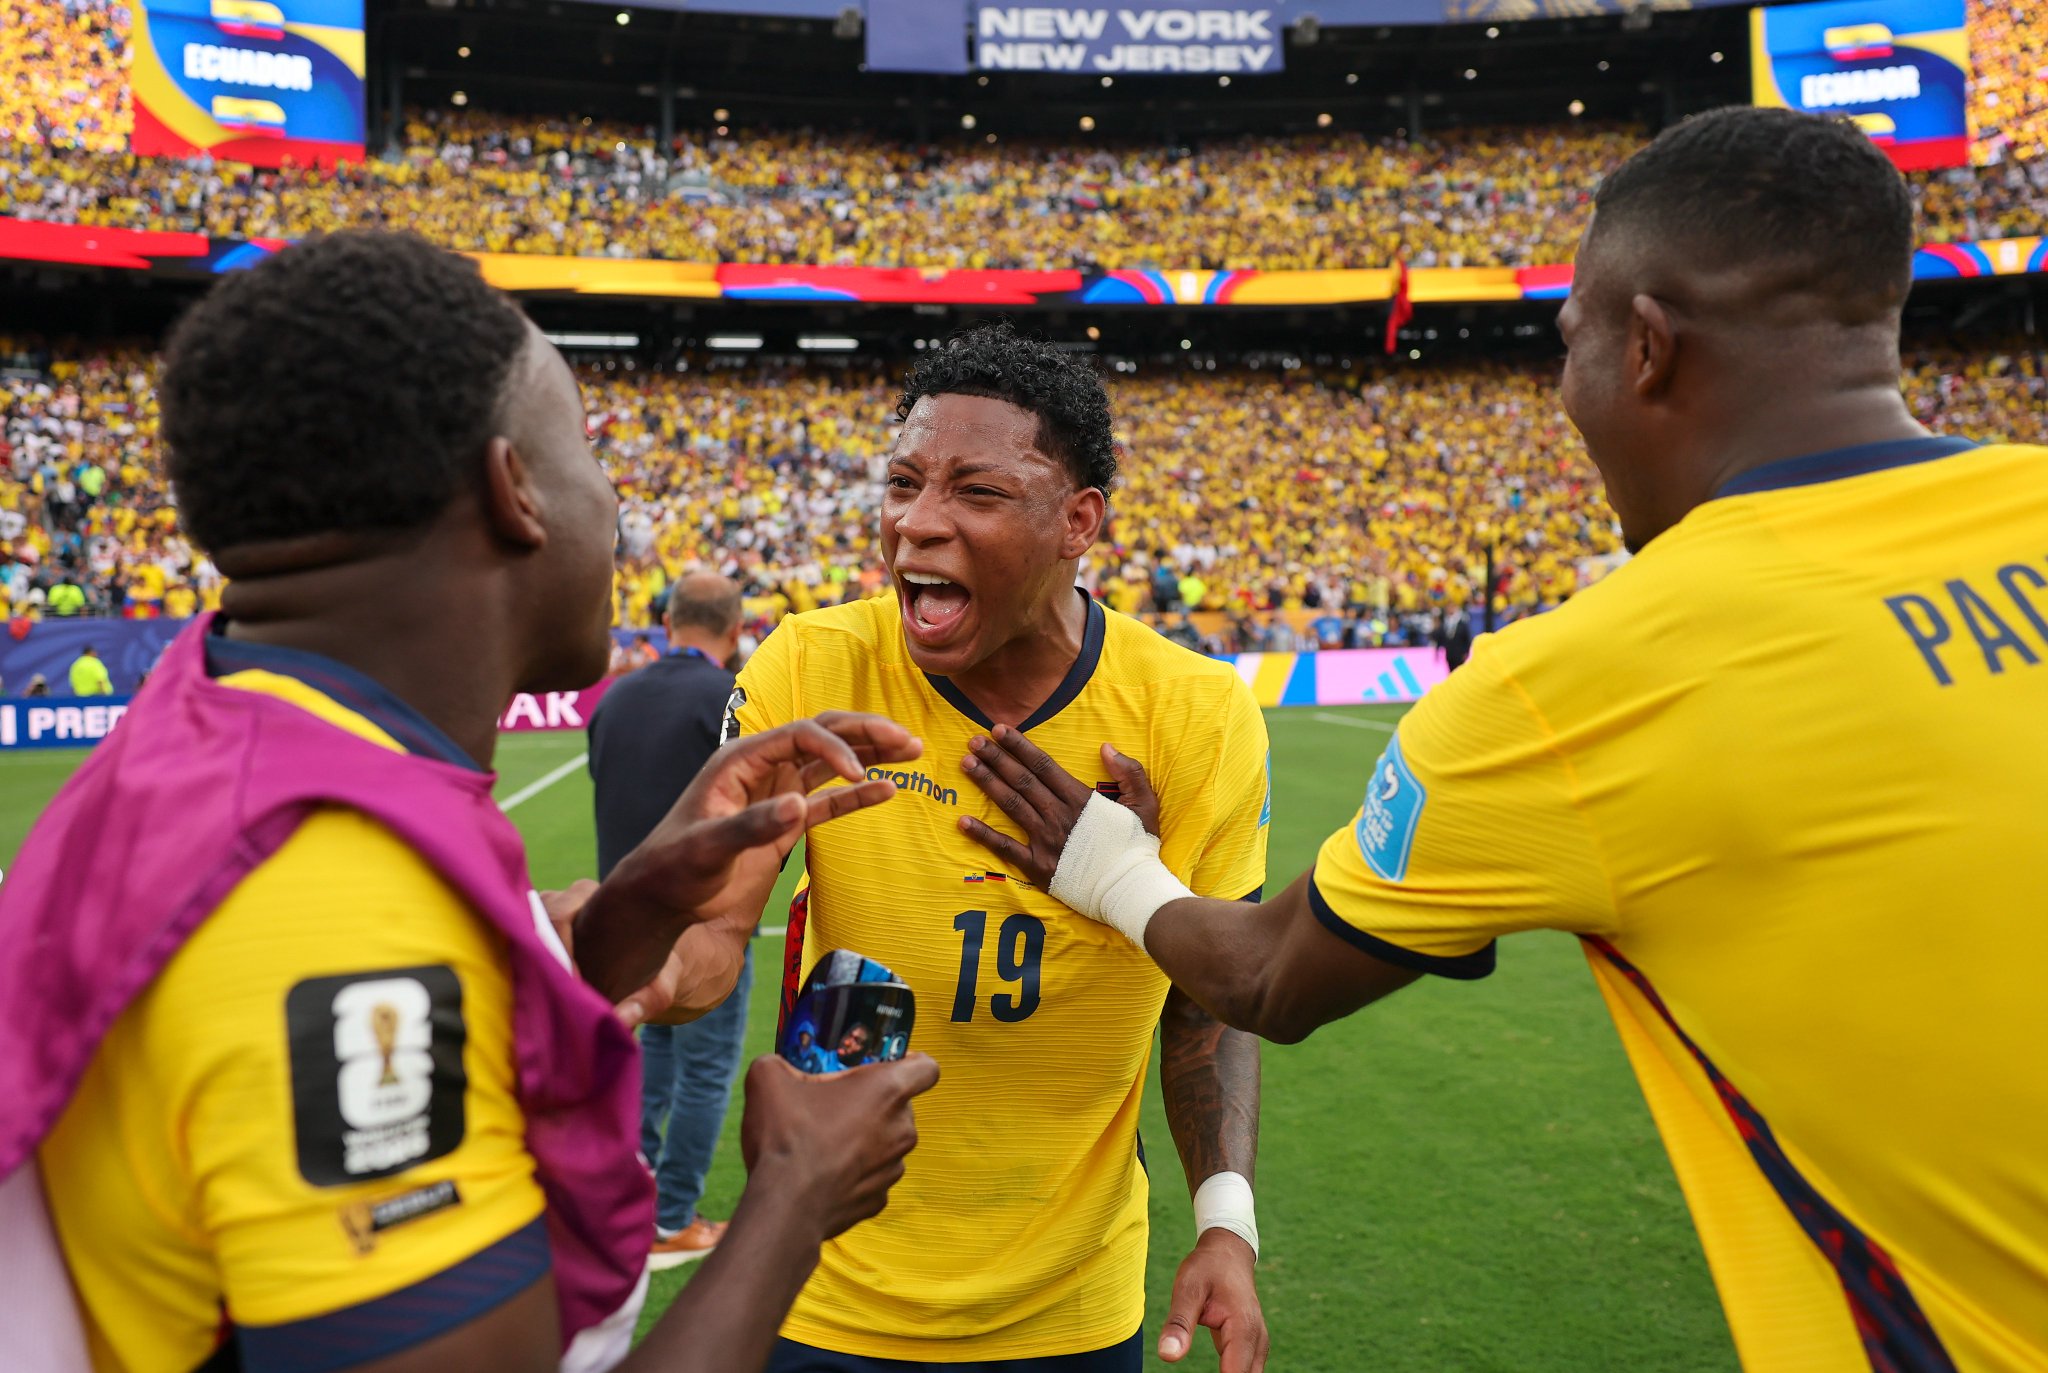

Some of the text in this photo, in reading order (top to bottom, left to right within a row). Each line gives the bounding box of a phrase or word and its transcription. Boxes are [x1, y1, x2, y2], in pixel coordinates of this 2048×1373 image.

[979, 8, 1273, 40] NEW YORK
[184, 42, 313, 92] ECUADOR
[979, 43, 1274, 72] NEW JERSEY
[1801, 64, 1921, 109] ECUADOR
[864, 767, 958, 806] arathon
[950, 909, 1047, 1023] 19
